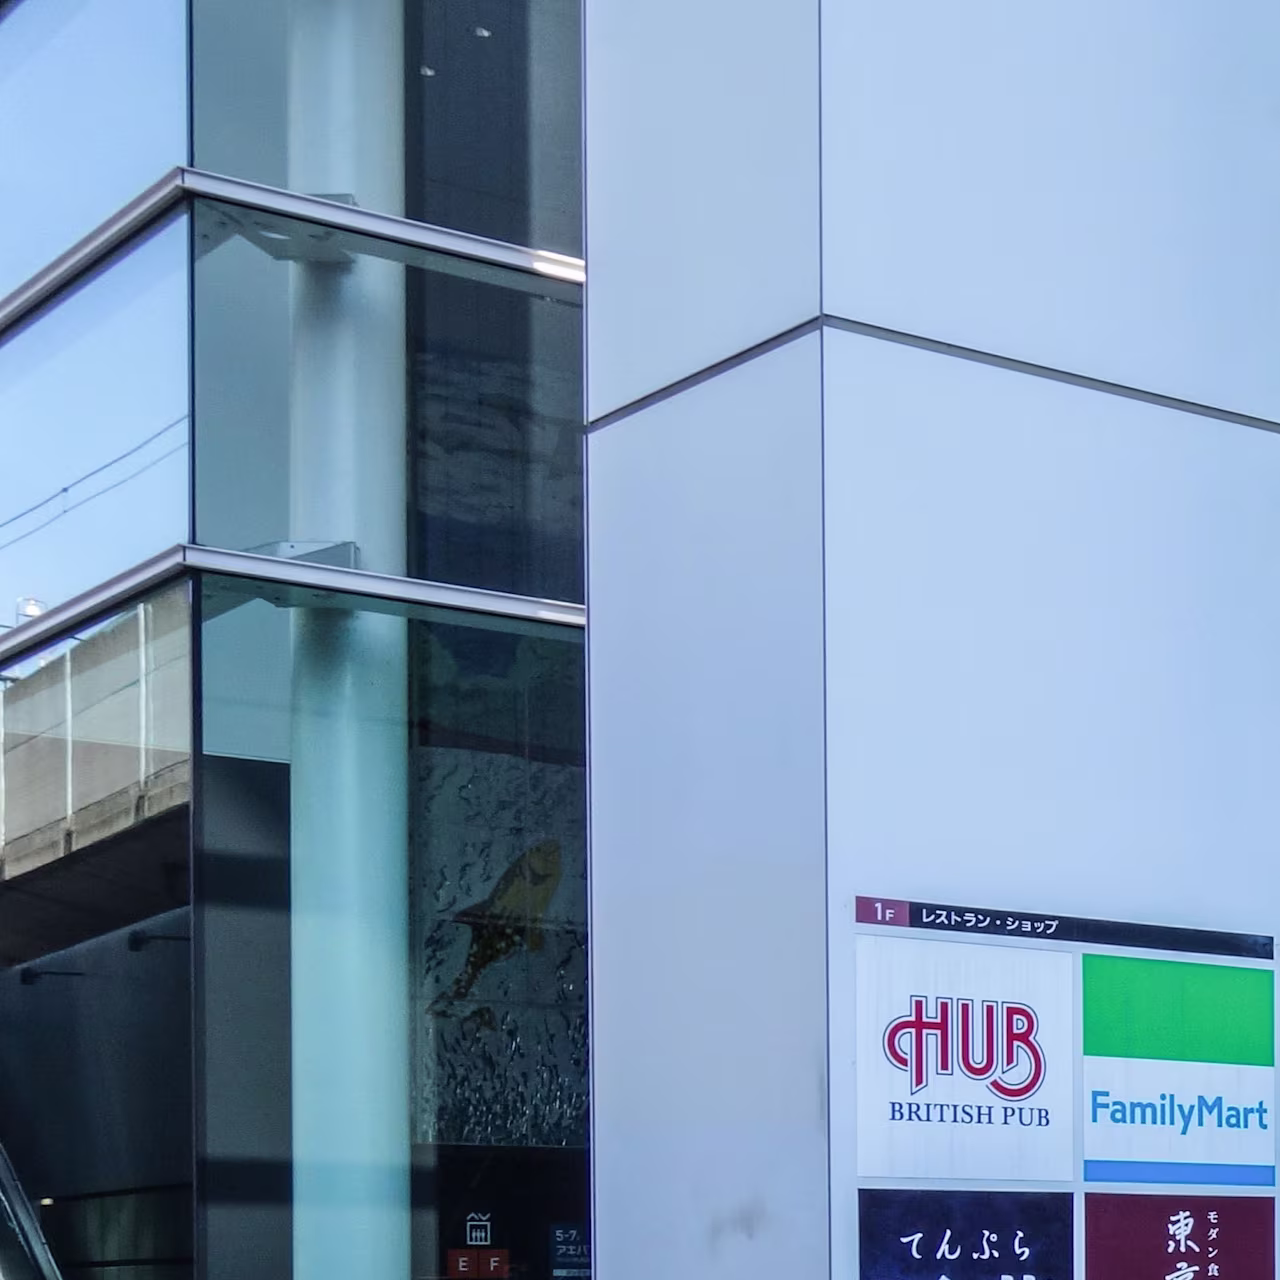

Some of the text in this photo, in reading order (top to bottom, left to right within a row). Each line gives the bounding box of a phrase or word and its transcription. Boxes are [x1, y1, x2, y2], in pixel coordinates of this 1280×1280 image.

[874, 903, 895, 922] 1F
[883, 995, 1047, 1101] HUB
[888, 1102, 1051, 1128] BRITISH PUB
[1090, 1091, 1268, 1135] FamilyMart
[899, 1229, 1031, 1261] てんぷら
[458, 1257, 469, 1271] E
[489, 1257, 500, 1271] F
